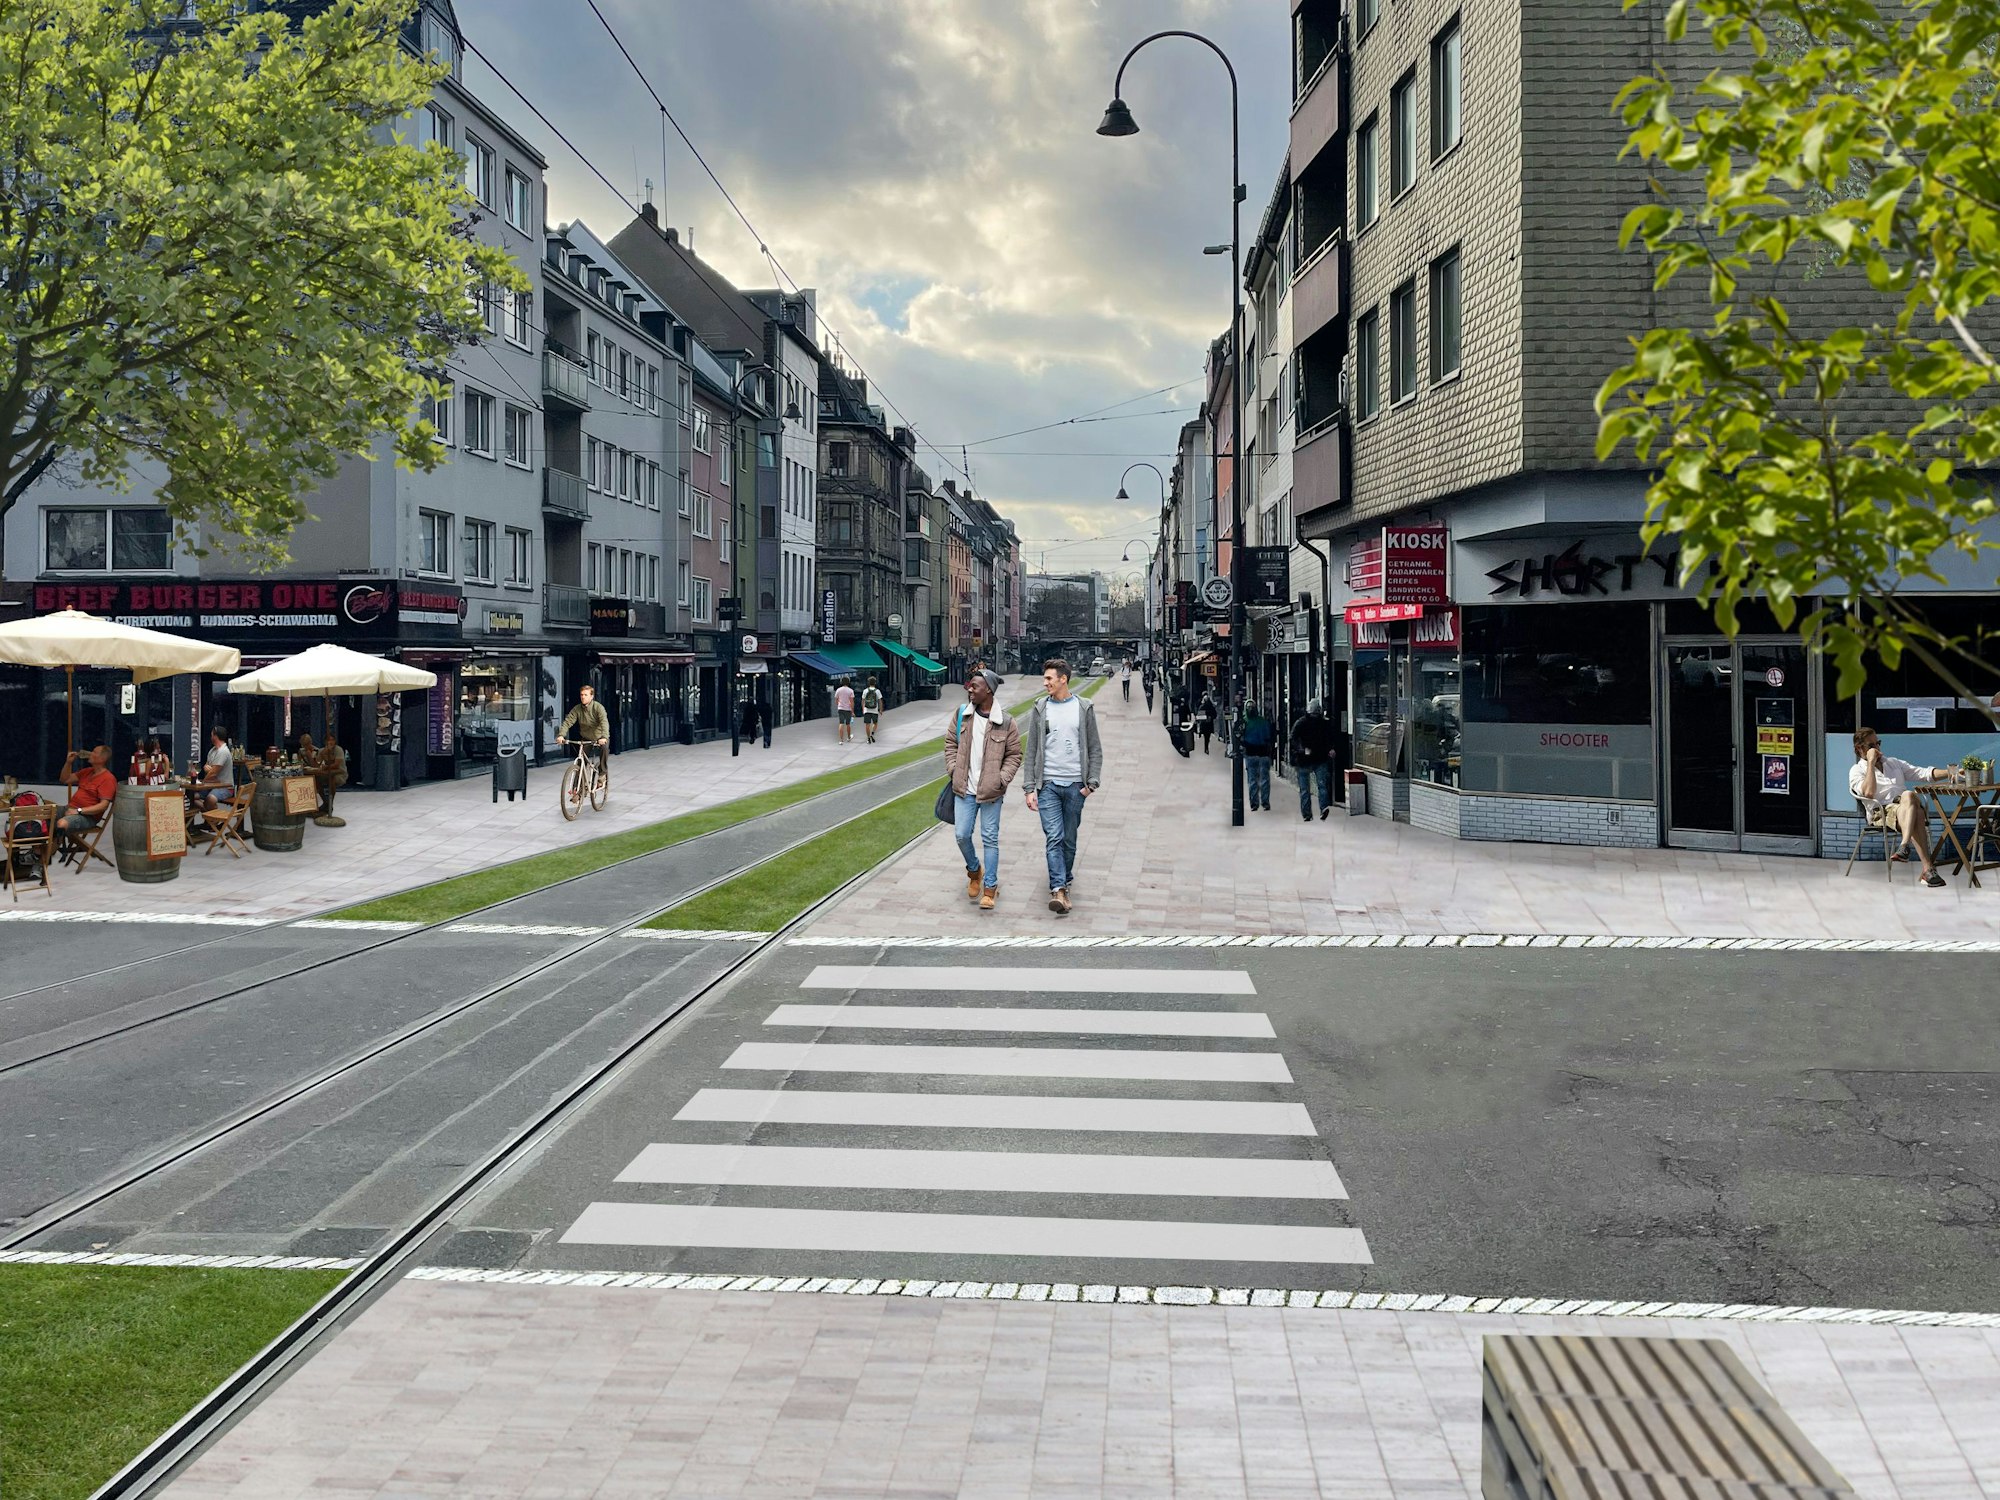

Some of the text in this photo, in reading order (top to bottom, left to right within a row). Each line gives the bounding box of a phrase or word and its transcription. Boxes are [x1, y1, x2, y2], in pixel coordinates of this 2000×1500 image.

[1387, 532, 1445, 550] KIOSK
[34, 584, 338, 610] BEEF BURGER ONE
[823, 590, 835, 643] Borsalino
[1416, 612, 1454, 642] KIOSK
[1357, 621, 1388, 644] KIOSK
[1540, 732, 1610, 748] SHOOTER
[1768, 761, 1786, 775] AHA
